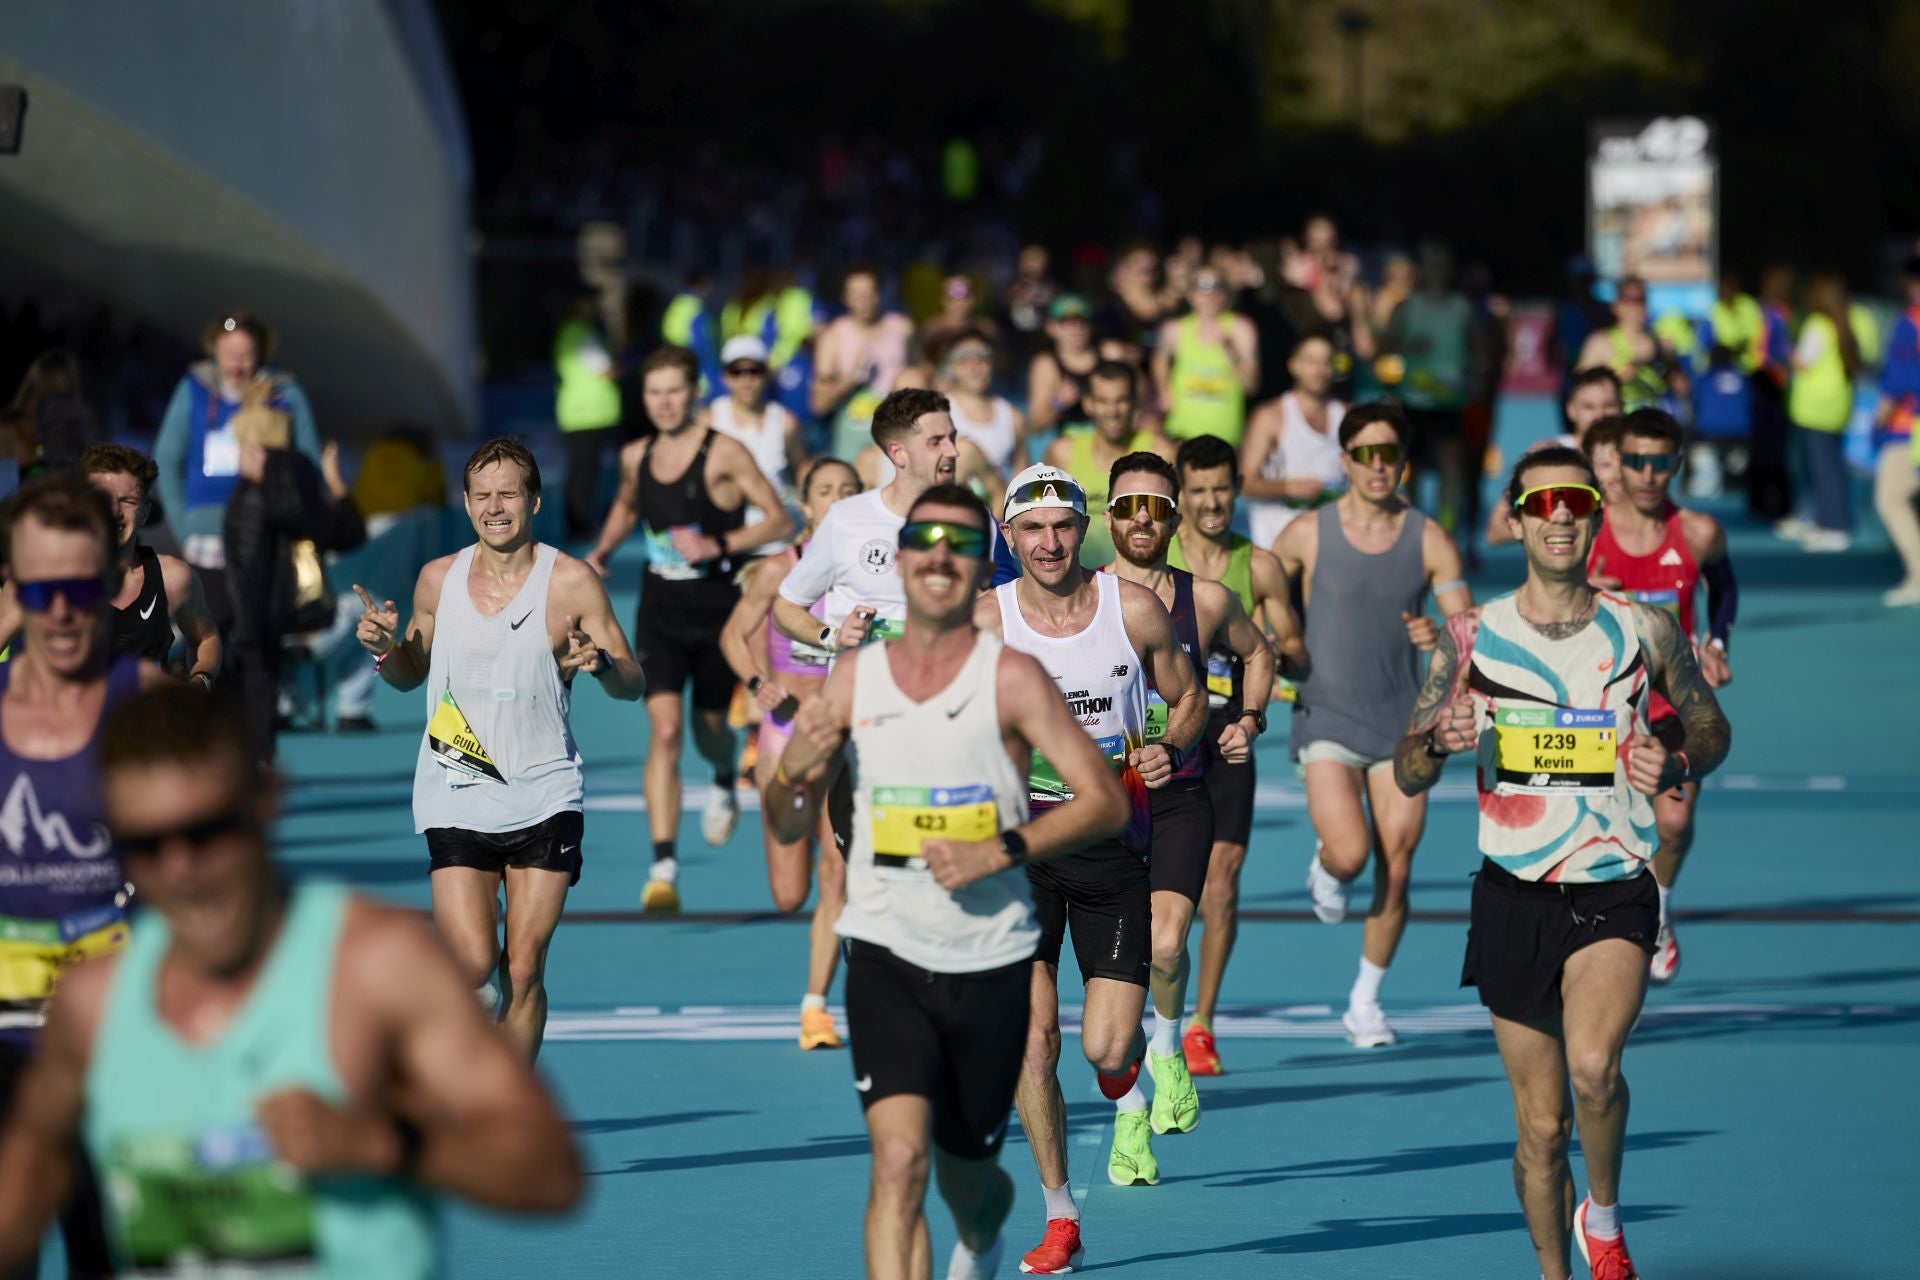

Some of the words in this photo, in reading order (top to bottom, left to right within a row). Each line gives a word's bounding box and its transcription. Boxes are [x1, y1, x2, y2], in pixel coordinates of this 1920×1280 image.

[1575, 715, 1604, 723] ZURICH
[1533, 734, 1576, 750] 1239
[1534, 755, 1574, 769] Kevin
[914, 814, 947, 831] 423
